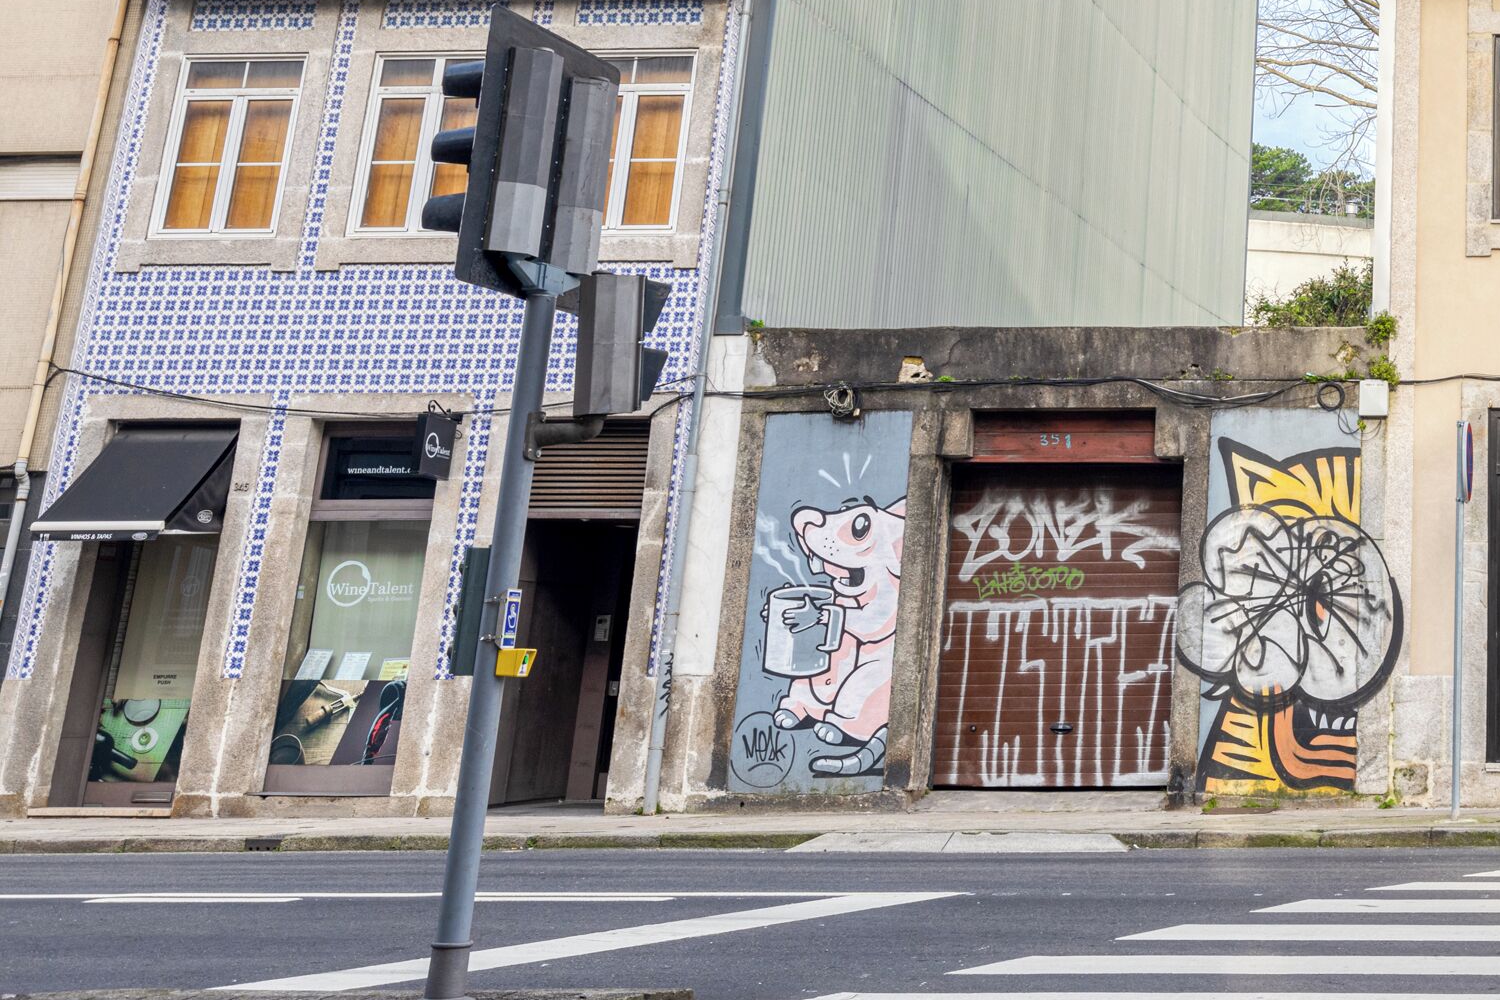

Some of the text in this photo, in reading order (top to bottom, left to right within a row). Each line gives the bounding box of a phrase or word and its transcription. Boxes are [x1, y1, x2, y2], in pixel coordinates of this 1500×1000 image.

[1040, 432, 1072, 449] 351
[330, 581, 414, 596] Wine Talent
